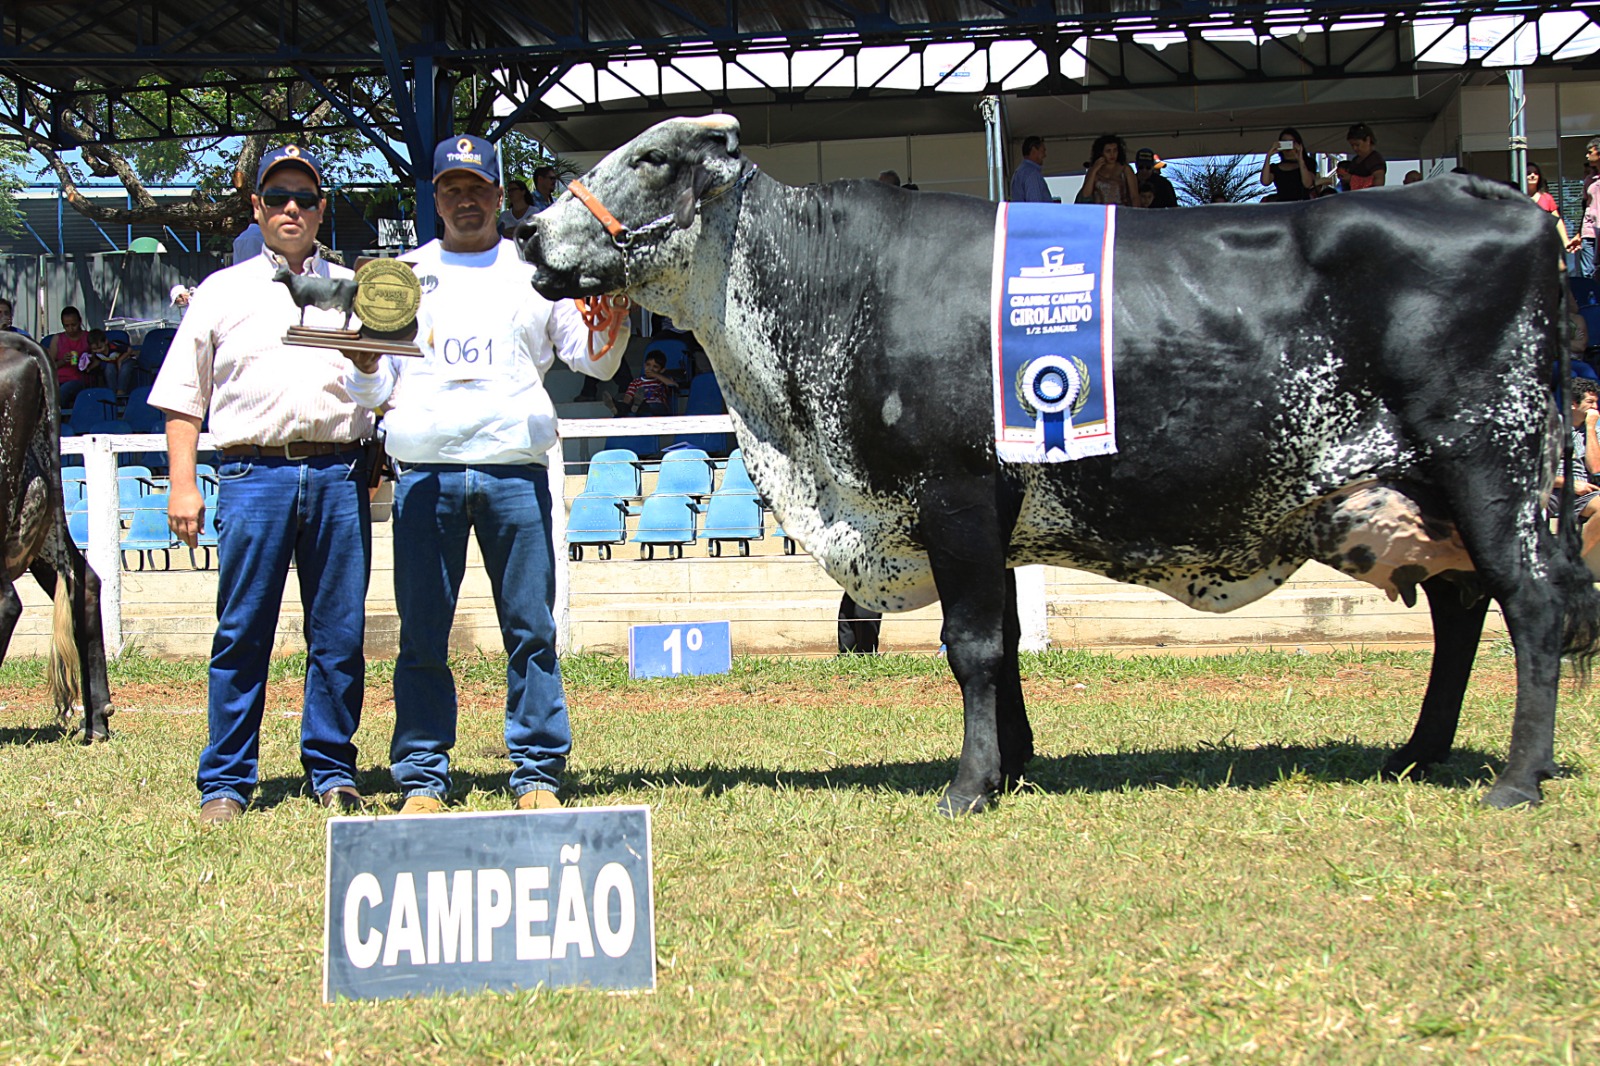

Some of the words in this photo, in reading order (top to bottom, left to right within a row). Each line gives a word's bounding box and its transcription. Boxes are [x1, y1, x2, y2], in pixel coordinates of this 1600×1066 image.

[1010, 295, 1050, 307] GRANDE
[1051, 290, 1092, 305] CAMPEÃ
[1010, 304, 1092, 326] GIROLANDO
[1026, 327, 1041, 335] 1/2
[1042, 324, 1078, 333] SANGUE
[443, 336, 492, 365] 061
[343, 843, 636, 969] CAMPEÃO
